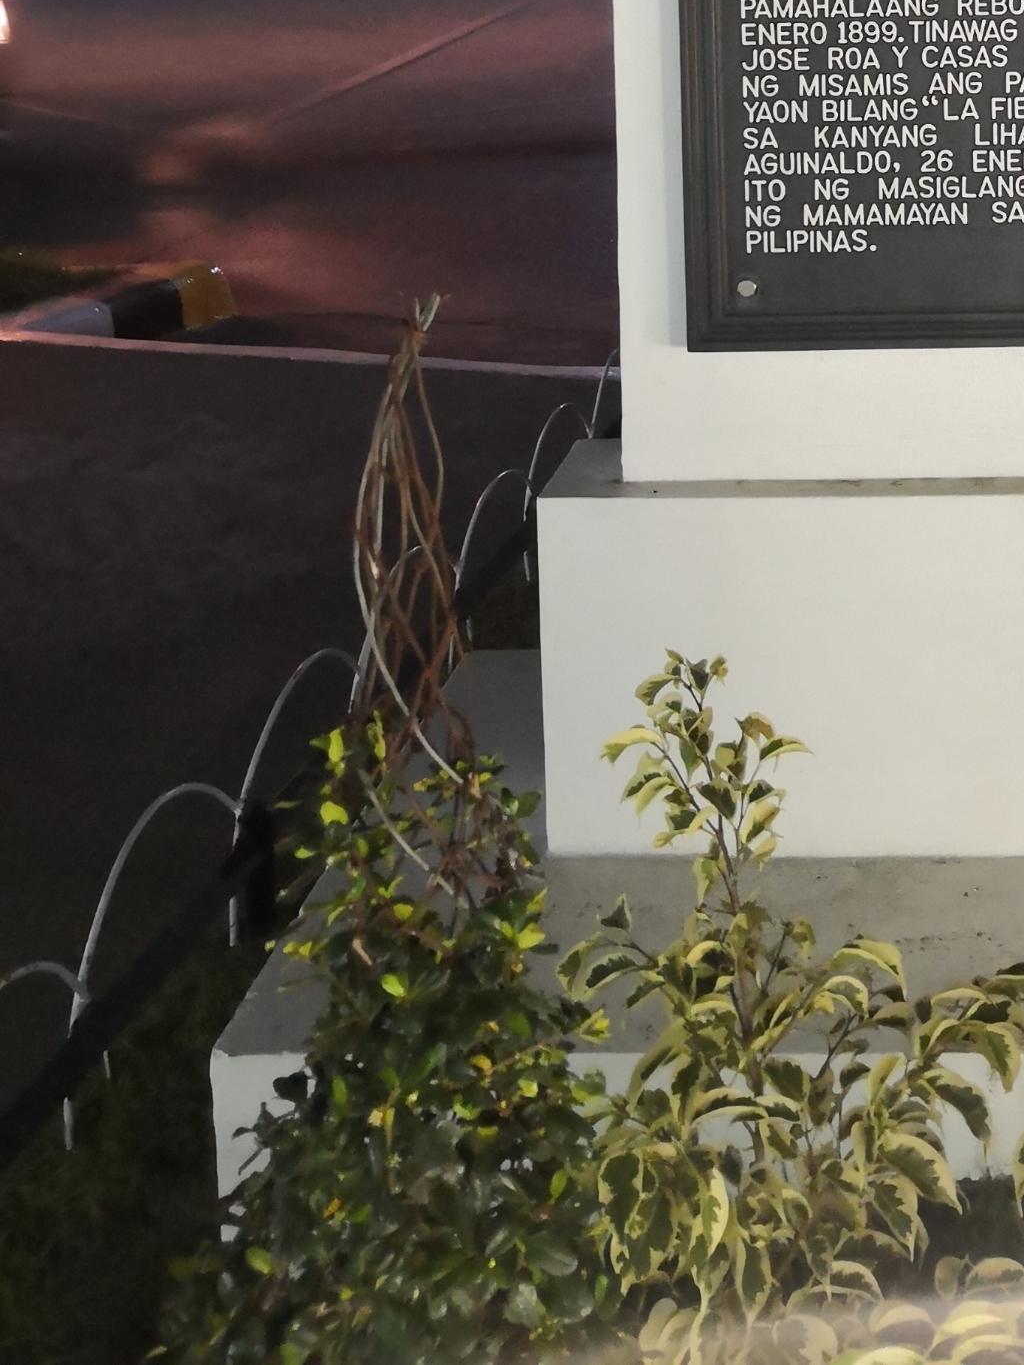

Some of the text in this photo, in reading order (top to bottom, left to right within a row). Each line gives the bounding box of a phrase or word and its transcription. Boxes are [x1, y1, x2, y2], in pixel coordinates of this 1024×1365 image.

[741, 21, 828, 46] ENERO
[908, 18, 1018, 44] TINAWAG
[741, 47, 811, 72] JOSE
[827, 46, 881, 70] ROA
[891, 45, 909, 69] Y
[921, 44, 1009, 69] CASAS
[742, 74, 779, 99] NG
[798, 72, 909, 98] MISAMIS
[928, 71, 983, 95] ANG
[743, 99, 809, 124] YAON
[822, 97, 919, 122] BILANG
[742, 126, 779, 150] SA
[814, 123, 938, 149] KANYANG
[743, 150, 901, 176] AGUINALDO,
[920, 149, 954, 173] 26
[744, 178, 786, 202] ITO
[814, 177, 850, 201] NG
[745, 204, 781, 228] NG
[803, 201, 969, 227] MAMAMAYAN
[746, 228, 877, 254] PILIPINAS.
